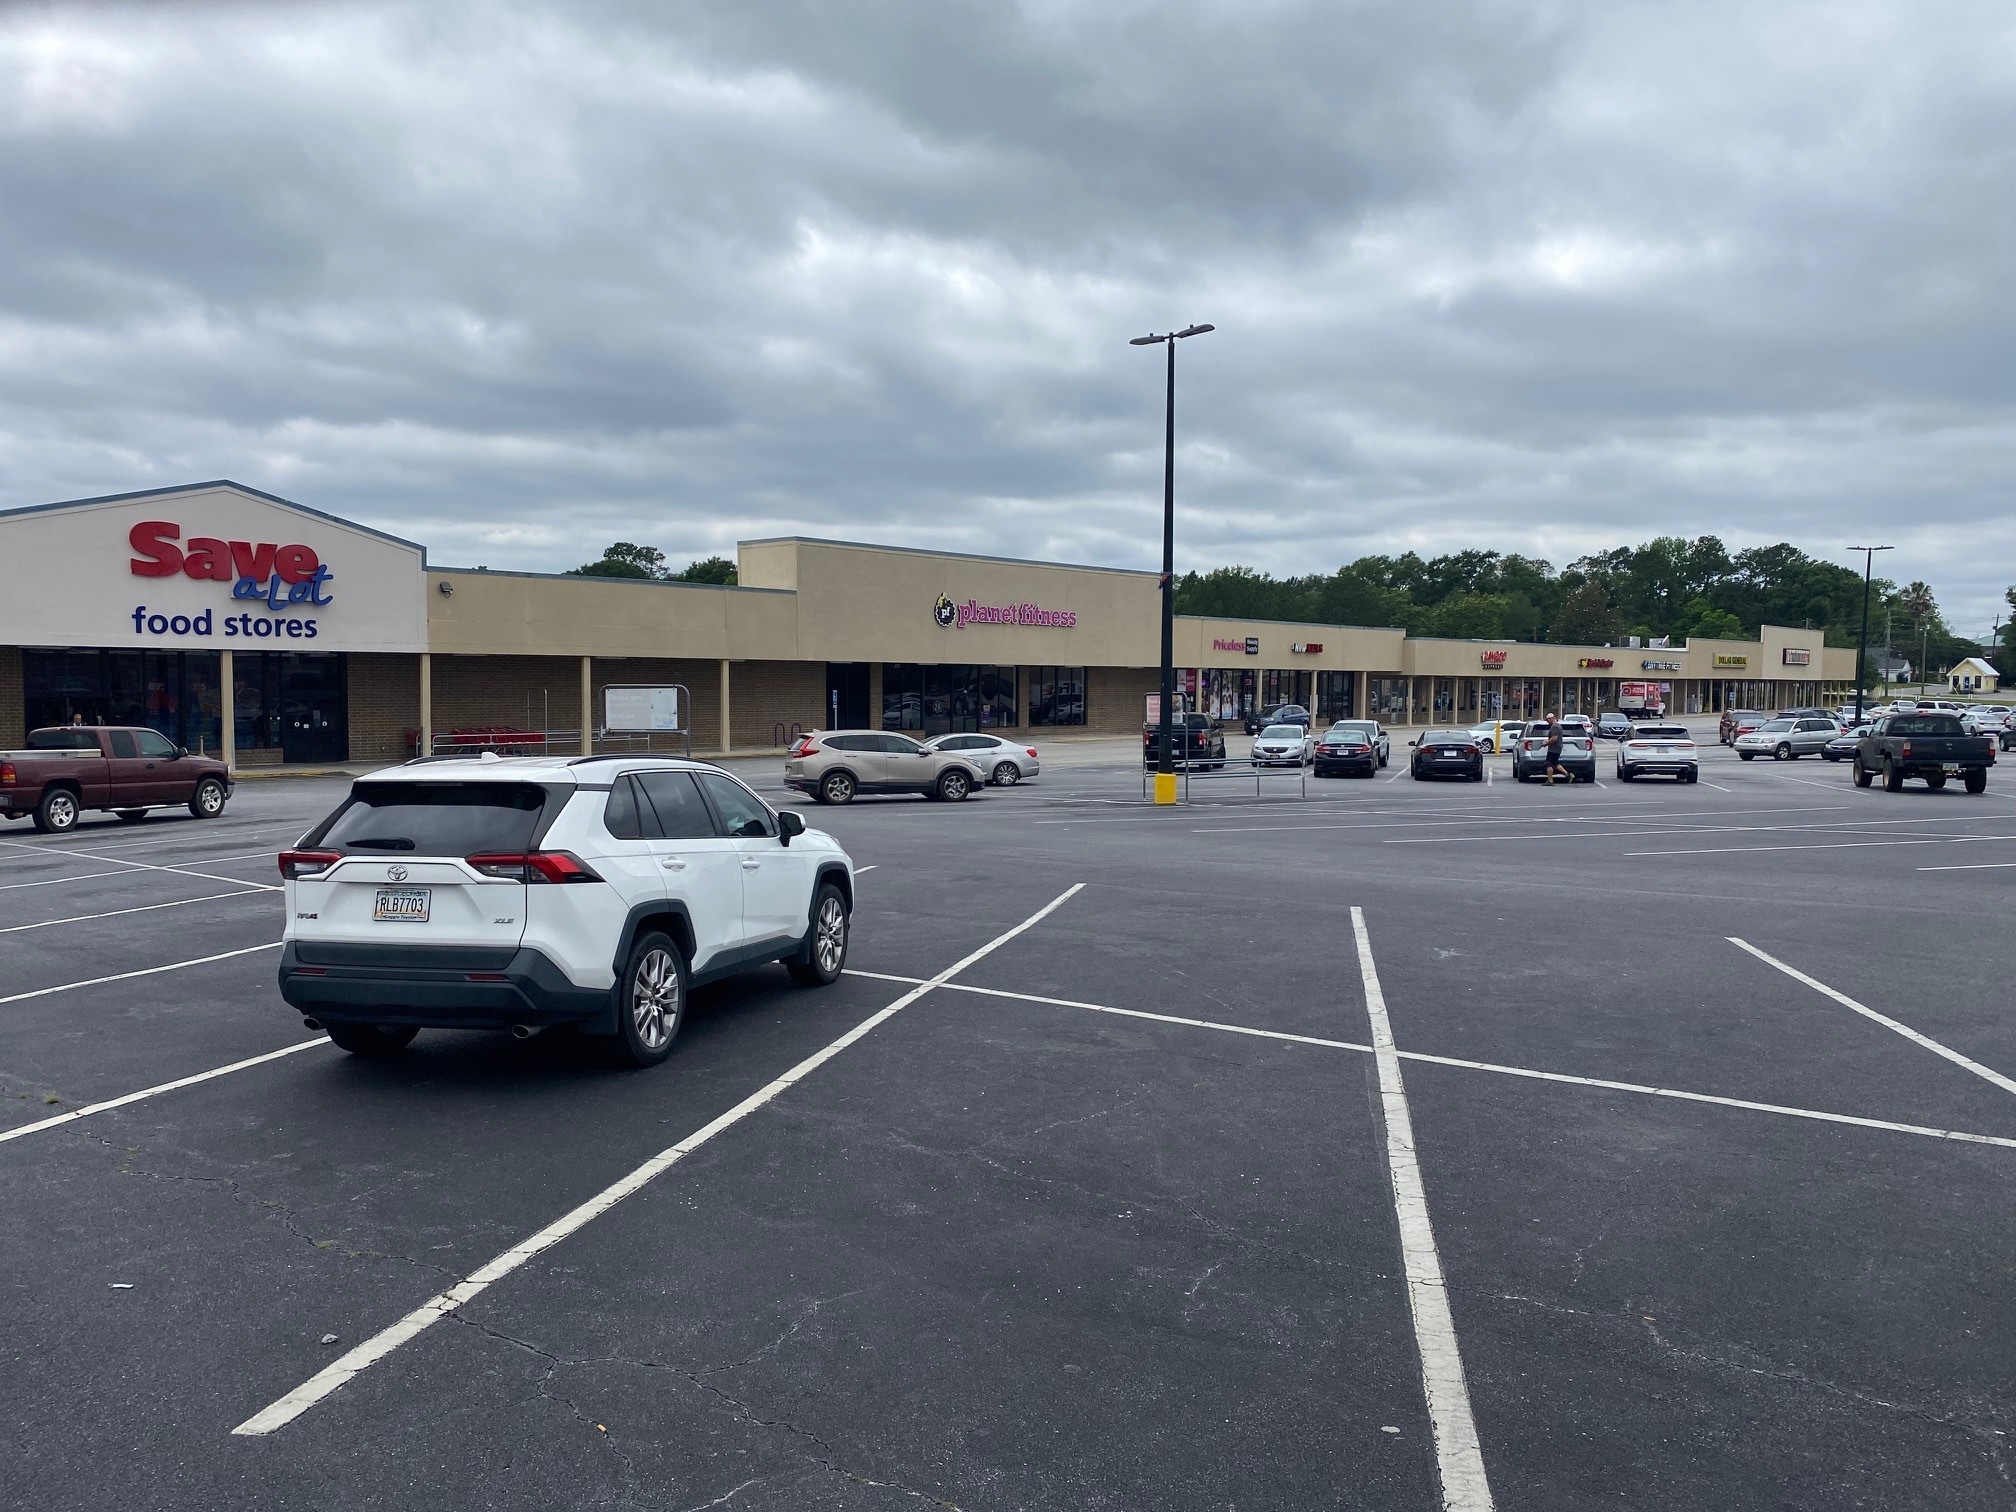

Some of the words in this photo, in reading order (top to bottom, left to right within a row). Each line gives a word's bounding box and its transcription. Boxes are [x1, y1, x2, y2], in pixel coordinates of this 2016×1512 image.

[129, 521, 319, 585] Save
[132, 606, 212, 636] food
[224, 613, 318, 638] stores
[957, 599, 1018, 628] planet
[1020, 602, 1077, 627] fitness
[1213, 639, 1245, 651] Priceless
[1718, 656, 1732, 665] DOLLAR
[1732, 656, 1747, 665] GENERAL
[380, 897, 423, 912] RLB7703
